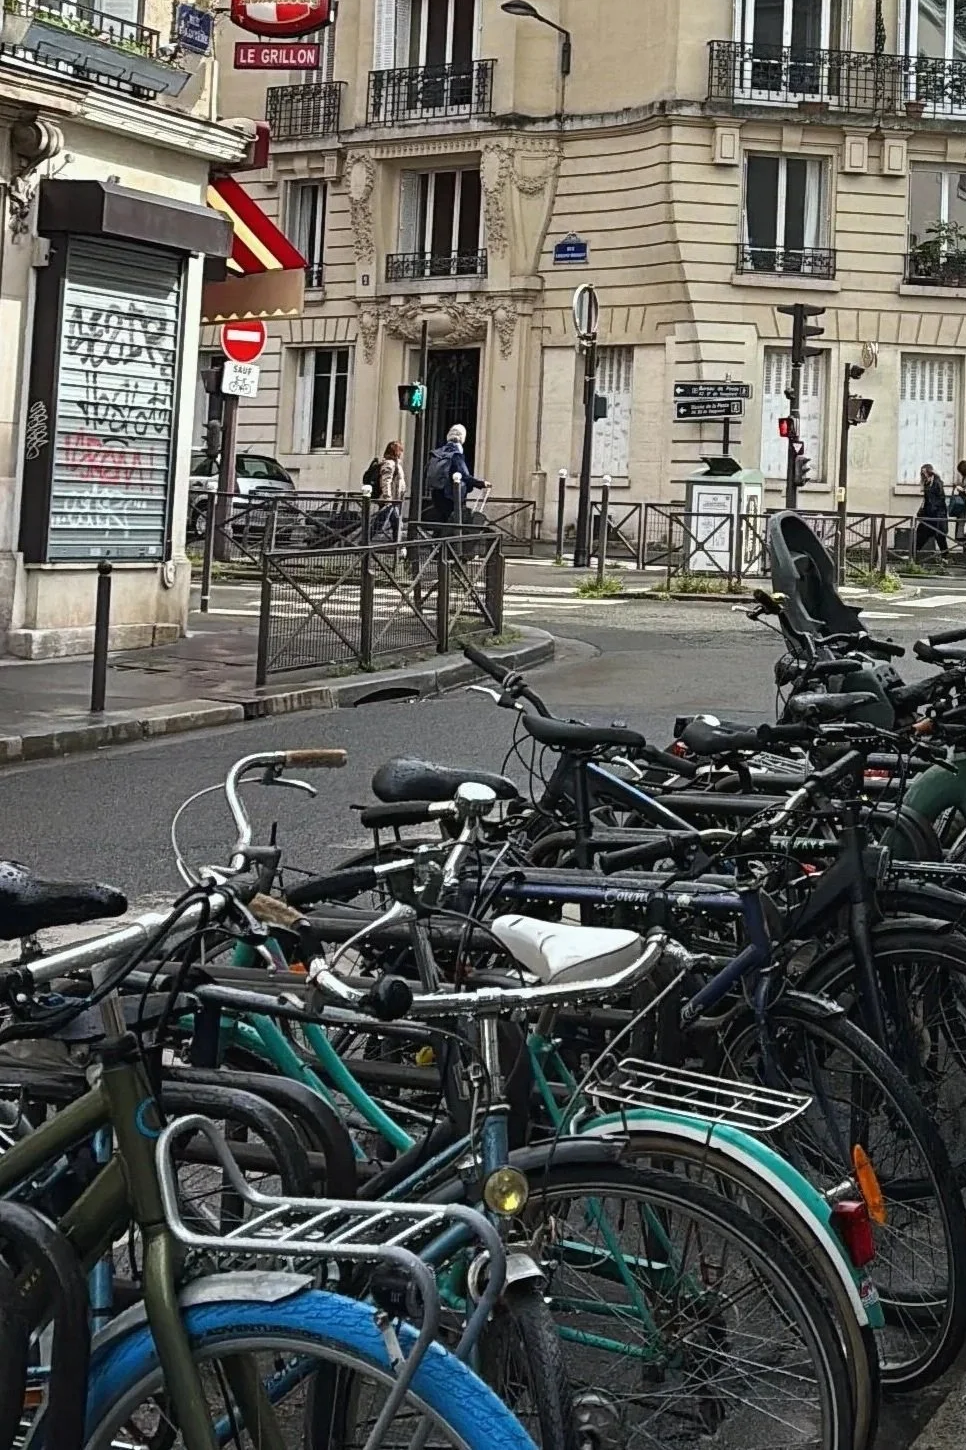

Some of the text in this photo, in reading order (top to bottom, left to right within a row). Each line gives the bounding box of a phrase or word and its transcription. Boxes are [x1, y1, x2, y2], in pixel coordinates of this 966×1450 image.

[240, 49, 315, 64] LE GRILLON
[233, 365, 252, 375] SAUF
